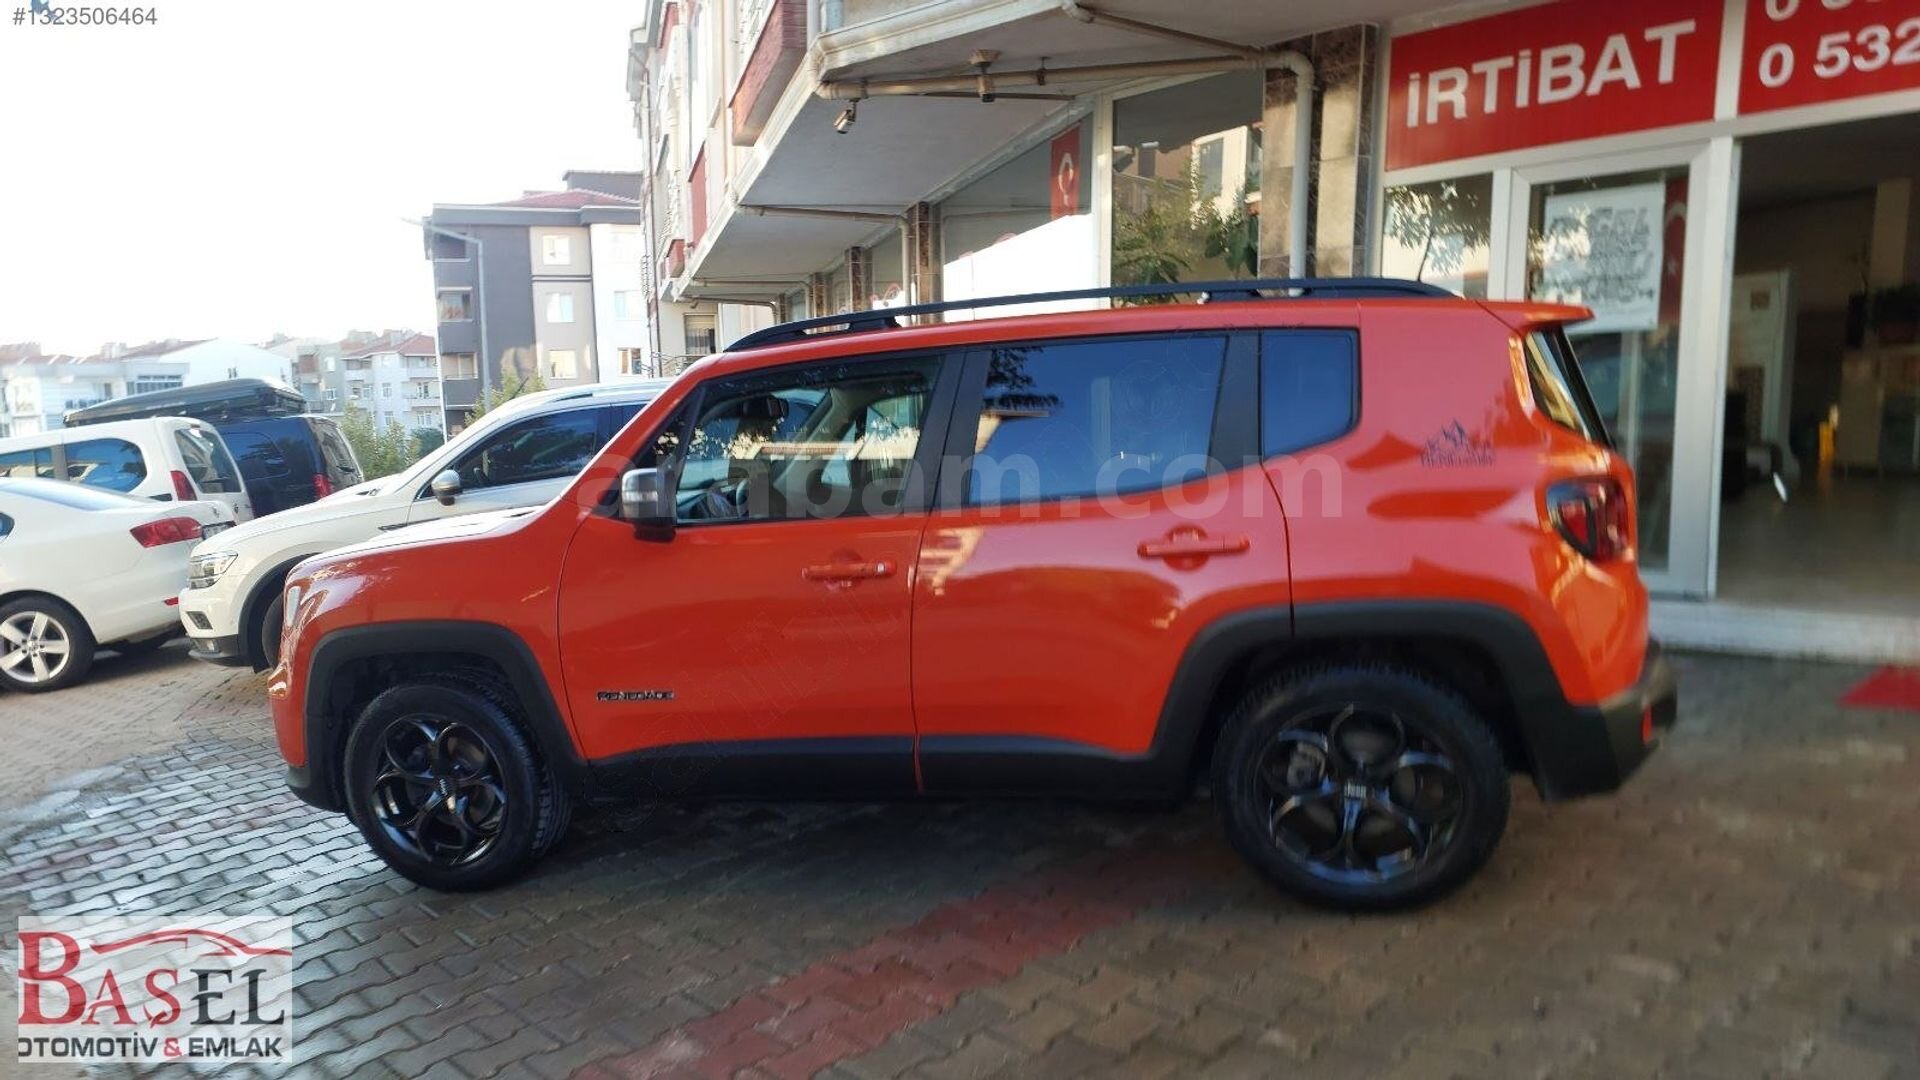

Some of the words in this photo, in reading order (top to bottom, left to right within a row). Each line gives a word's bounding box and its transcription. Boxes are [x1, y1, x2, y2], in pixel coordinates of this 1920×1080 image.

[1406, 18, 1696, 128] İRTİBAT
[1758, 42, 1795, 88] 0
[1812, 16, 1920, 79] 532
